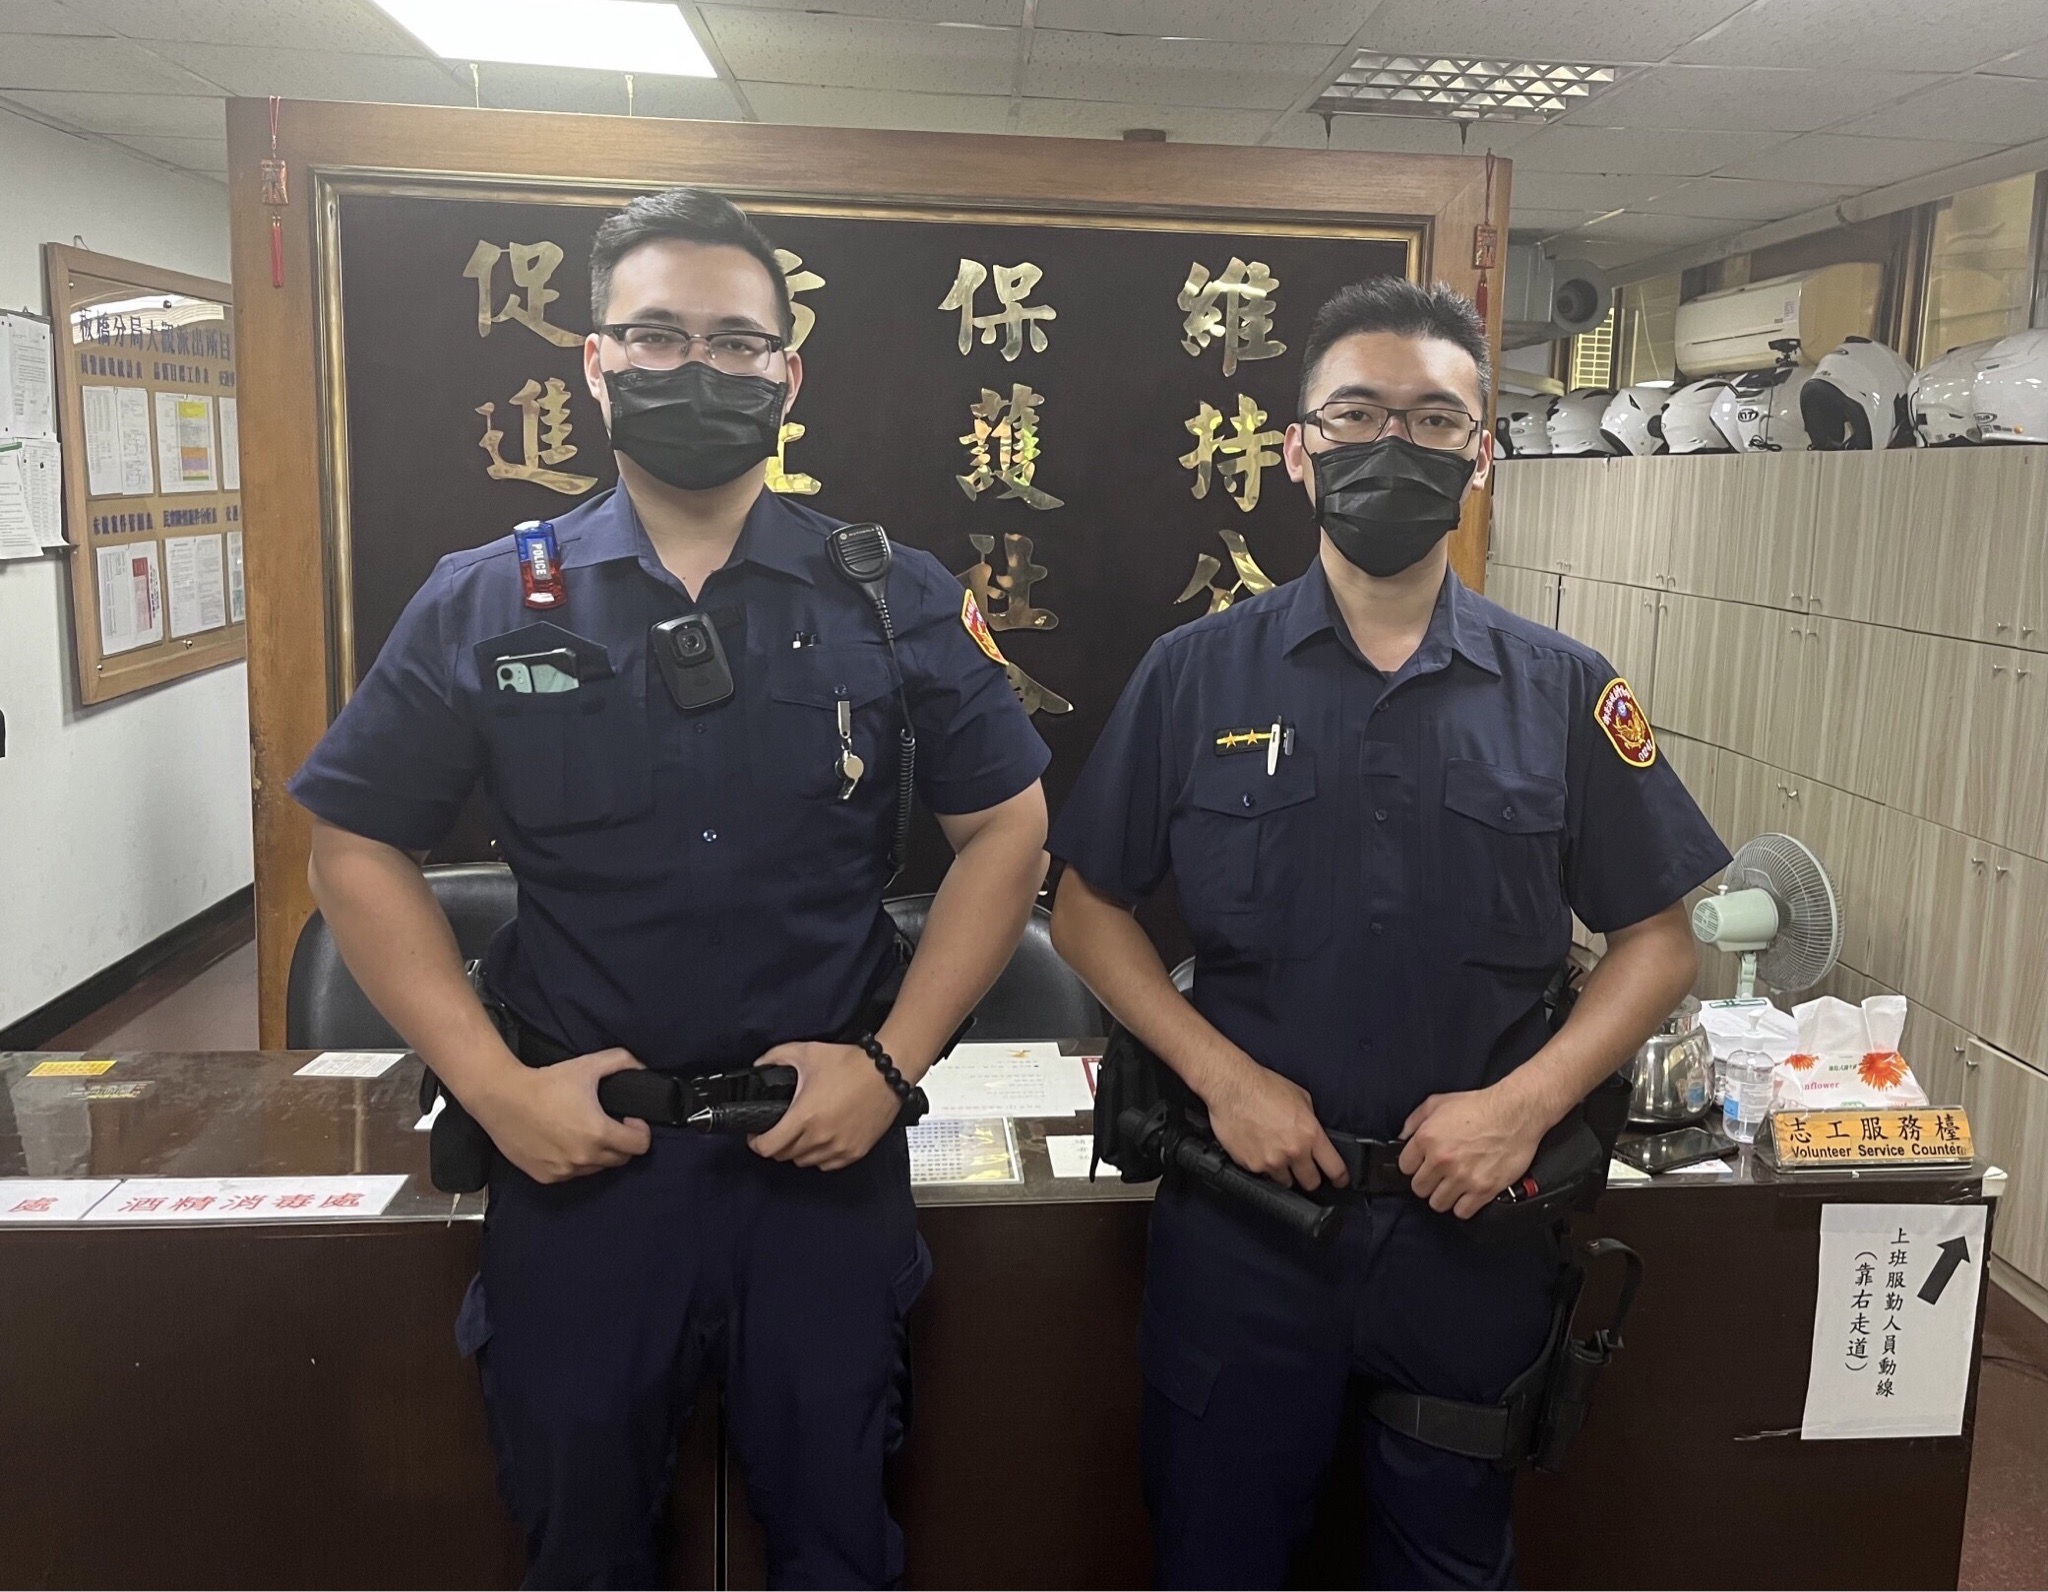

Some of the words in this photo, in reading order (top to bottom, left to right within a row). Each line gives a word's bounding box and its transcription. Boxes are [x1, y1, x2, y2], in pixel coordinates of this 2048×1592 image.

[462, 240, 598, 495] 促進
[531, 543, 547, 576] POLICE
[1803, 1081, 1840, 1091] nflower
[1789, 1113, 1962, 1144] 志工服務檯
[1792, 1145, 1851, 1159] Volunteer
[1858, 1143, 1905, 1158] Service
[1911, 1142, 1963, 1157] Counter
[6, 1196, 59, 1213] 處
[117, 1192, 366, 1213] 酒精消毒處
[1875, 1227, 1911, 1398] 上班服勤人員動線
